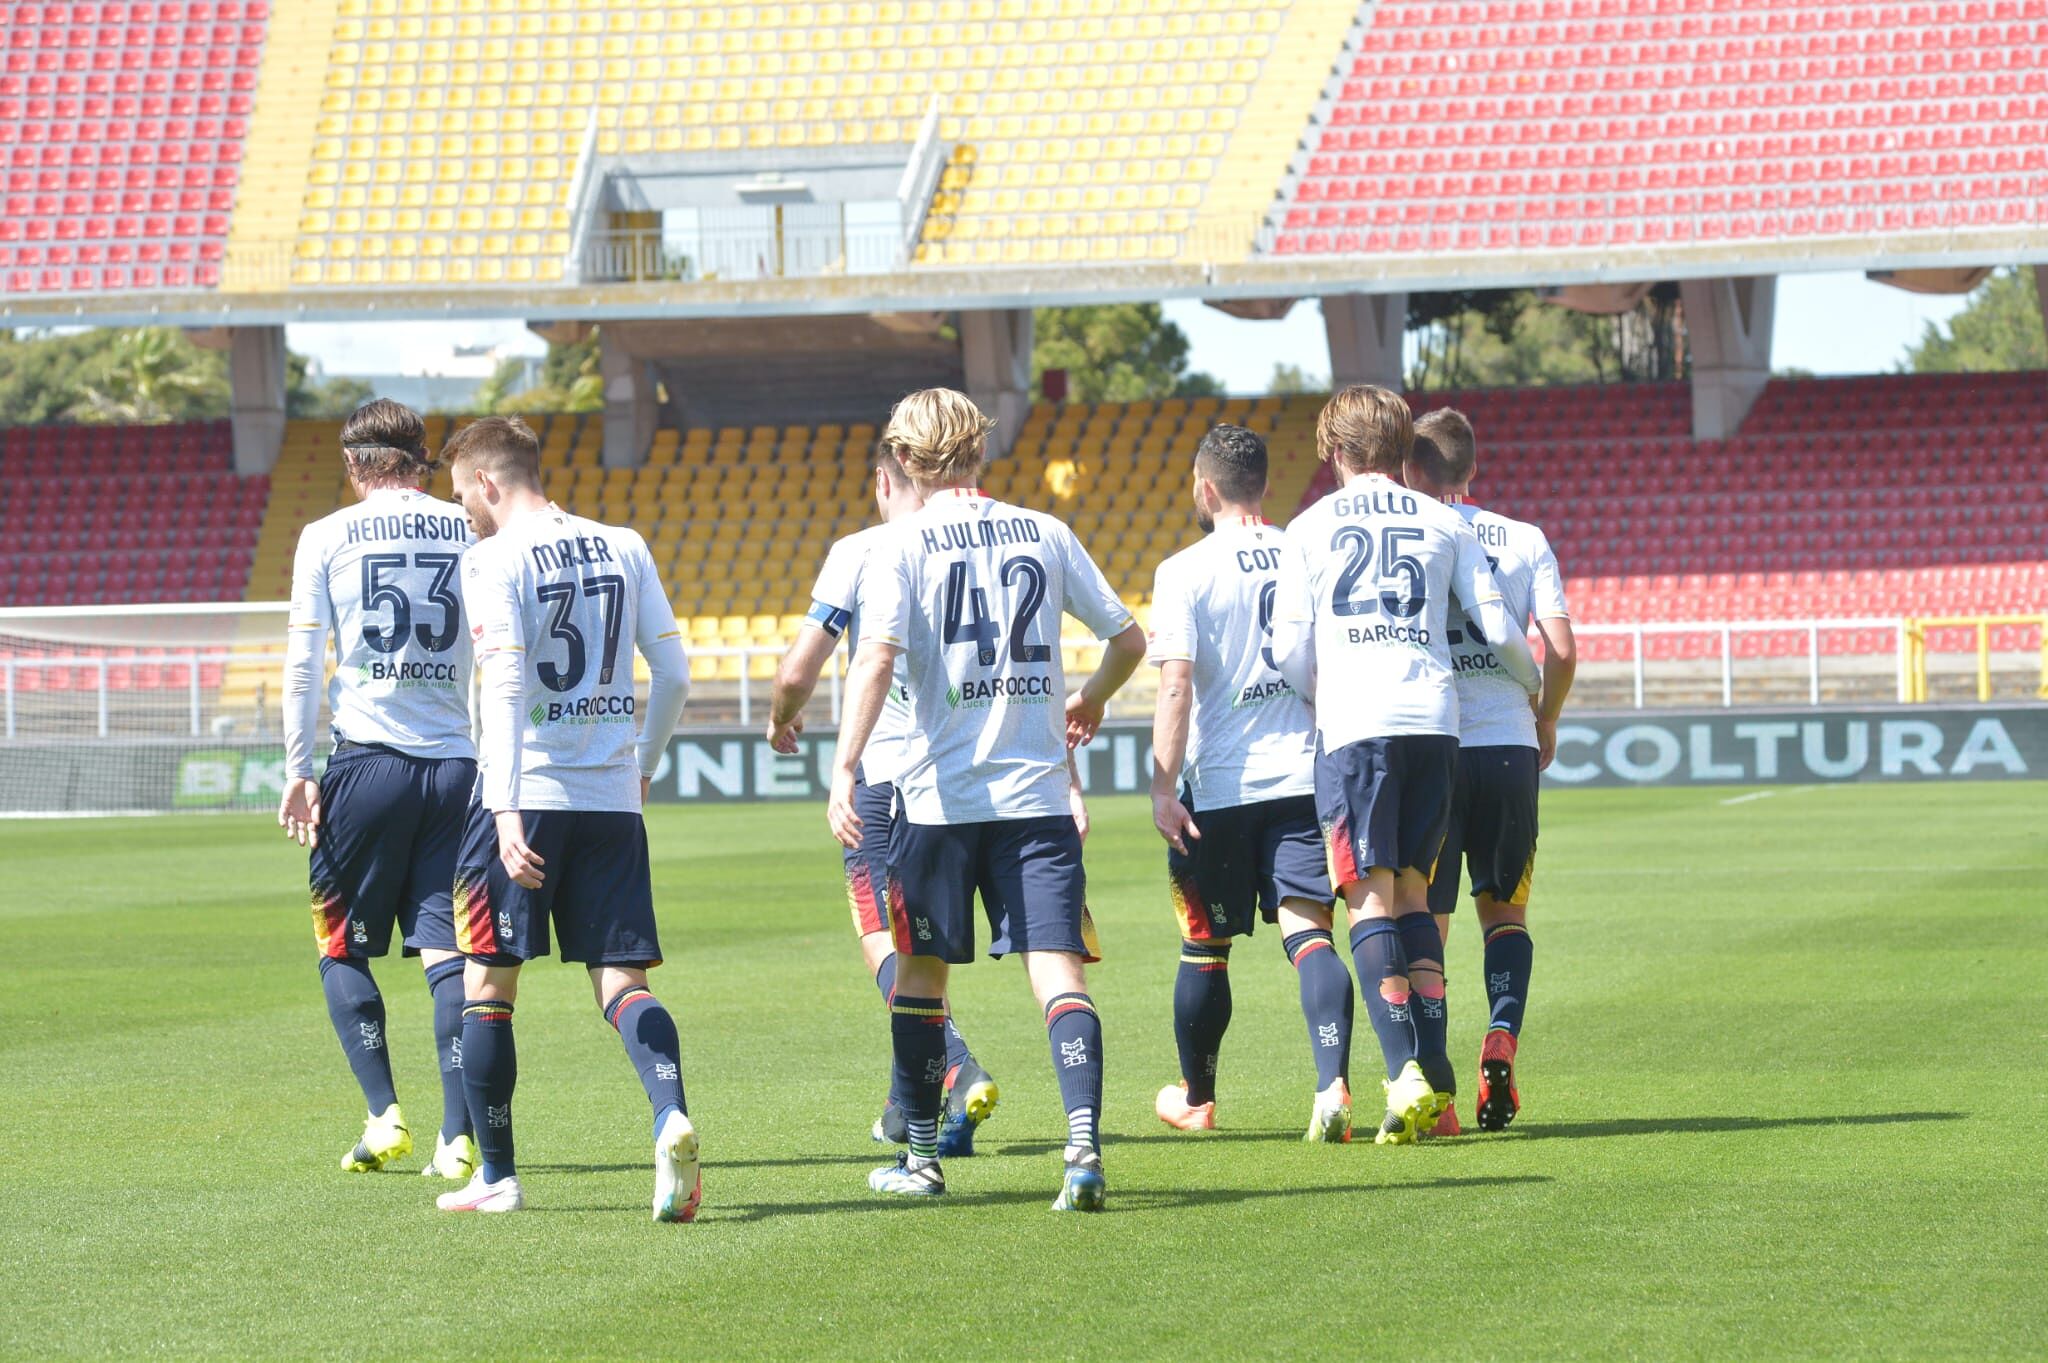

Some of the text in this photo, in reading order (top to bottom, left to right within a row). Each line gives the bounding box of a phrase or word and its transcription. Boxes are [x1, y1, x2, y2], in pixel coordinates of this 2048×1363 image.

[1334, 491, 1418, 517] GALLO
[346, 512, 467, 544] HENDERSON
[921, 517, 1041, 554] HJULMAND
[531, 536, 614, 574] MAJER
[1330, 525, 1426, 618] 25
[361, 552, 460, 654] 53
[943, 554, 1052, 667] 42
[536, 574, 625, 693] 37
[1347, 624, 1430, 646] BAROCCO
[372, 661, 457, 681] BAROCCO
[962, 676, 1051, 701] BAROCCO
[547, 695, 635, 721] BAROCCO
